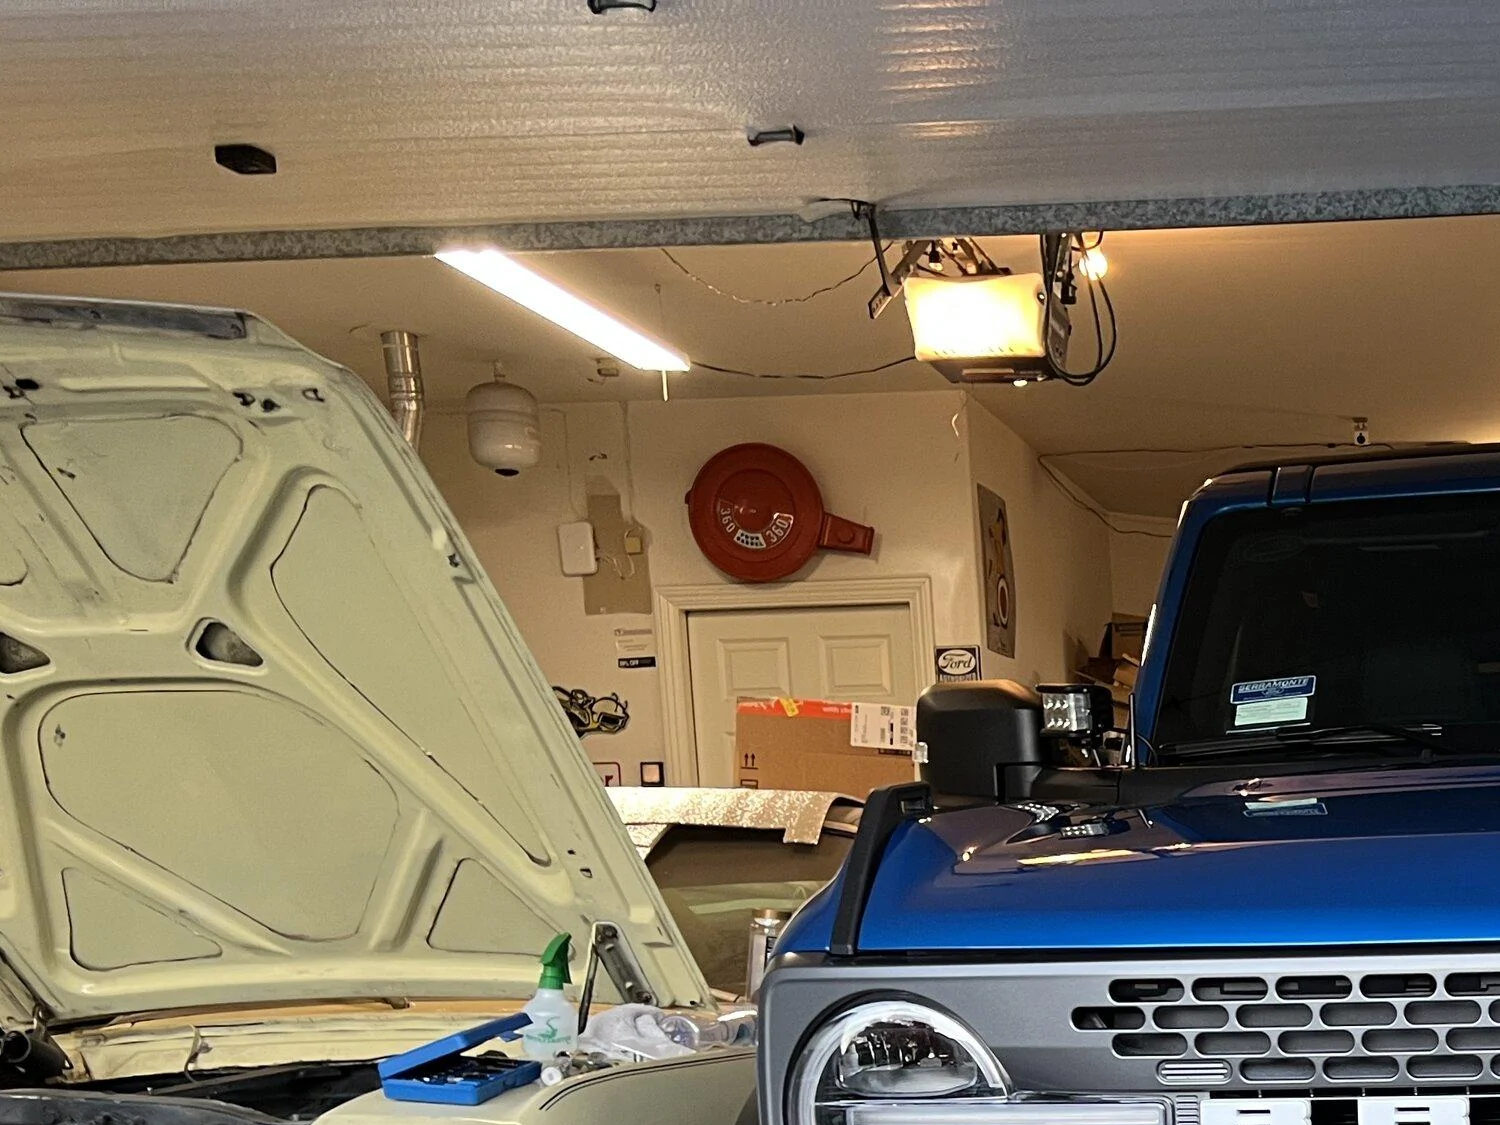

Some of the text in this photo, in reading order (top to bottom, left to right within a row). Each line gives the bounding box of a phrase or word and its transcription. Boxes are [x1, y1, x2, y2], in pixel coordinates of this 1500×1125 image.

[720, 507, 736, 533] 360
[765, 518, 789, 543] 360
[940, 653, 973, 669] Ford
[1238, 677, 1309, 694] SERRAMONTE
